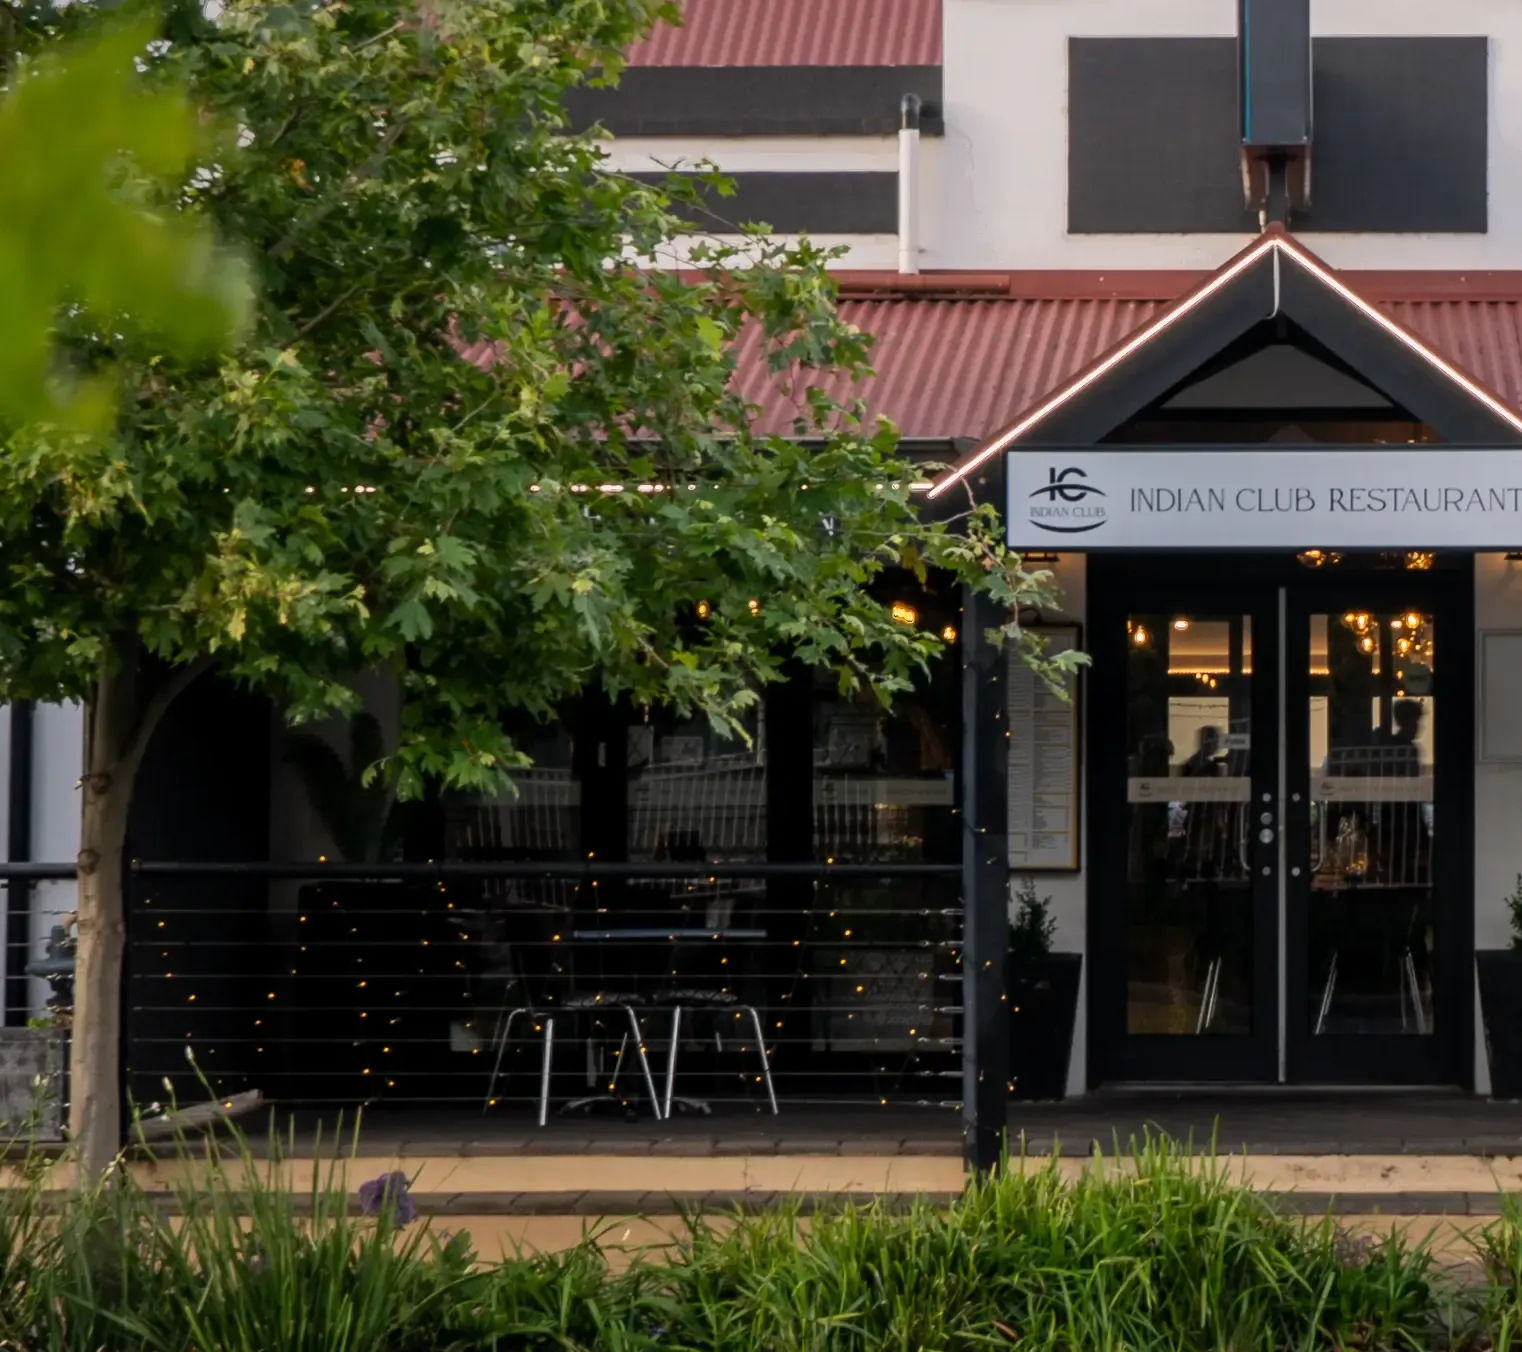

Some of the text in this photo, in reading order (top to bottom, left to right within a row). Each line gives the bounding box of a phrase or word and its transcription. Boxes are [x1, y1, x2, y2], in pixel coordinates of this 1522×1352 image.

[1131, 488, 1225, 512] INDIAN
[1235, 488, 1316, 512] CLUB
[1029, 506, 1106, 518] INDIAN CLUB
